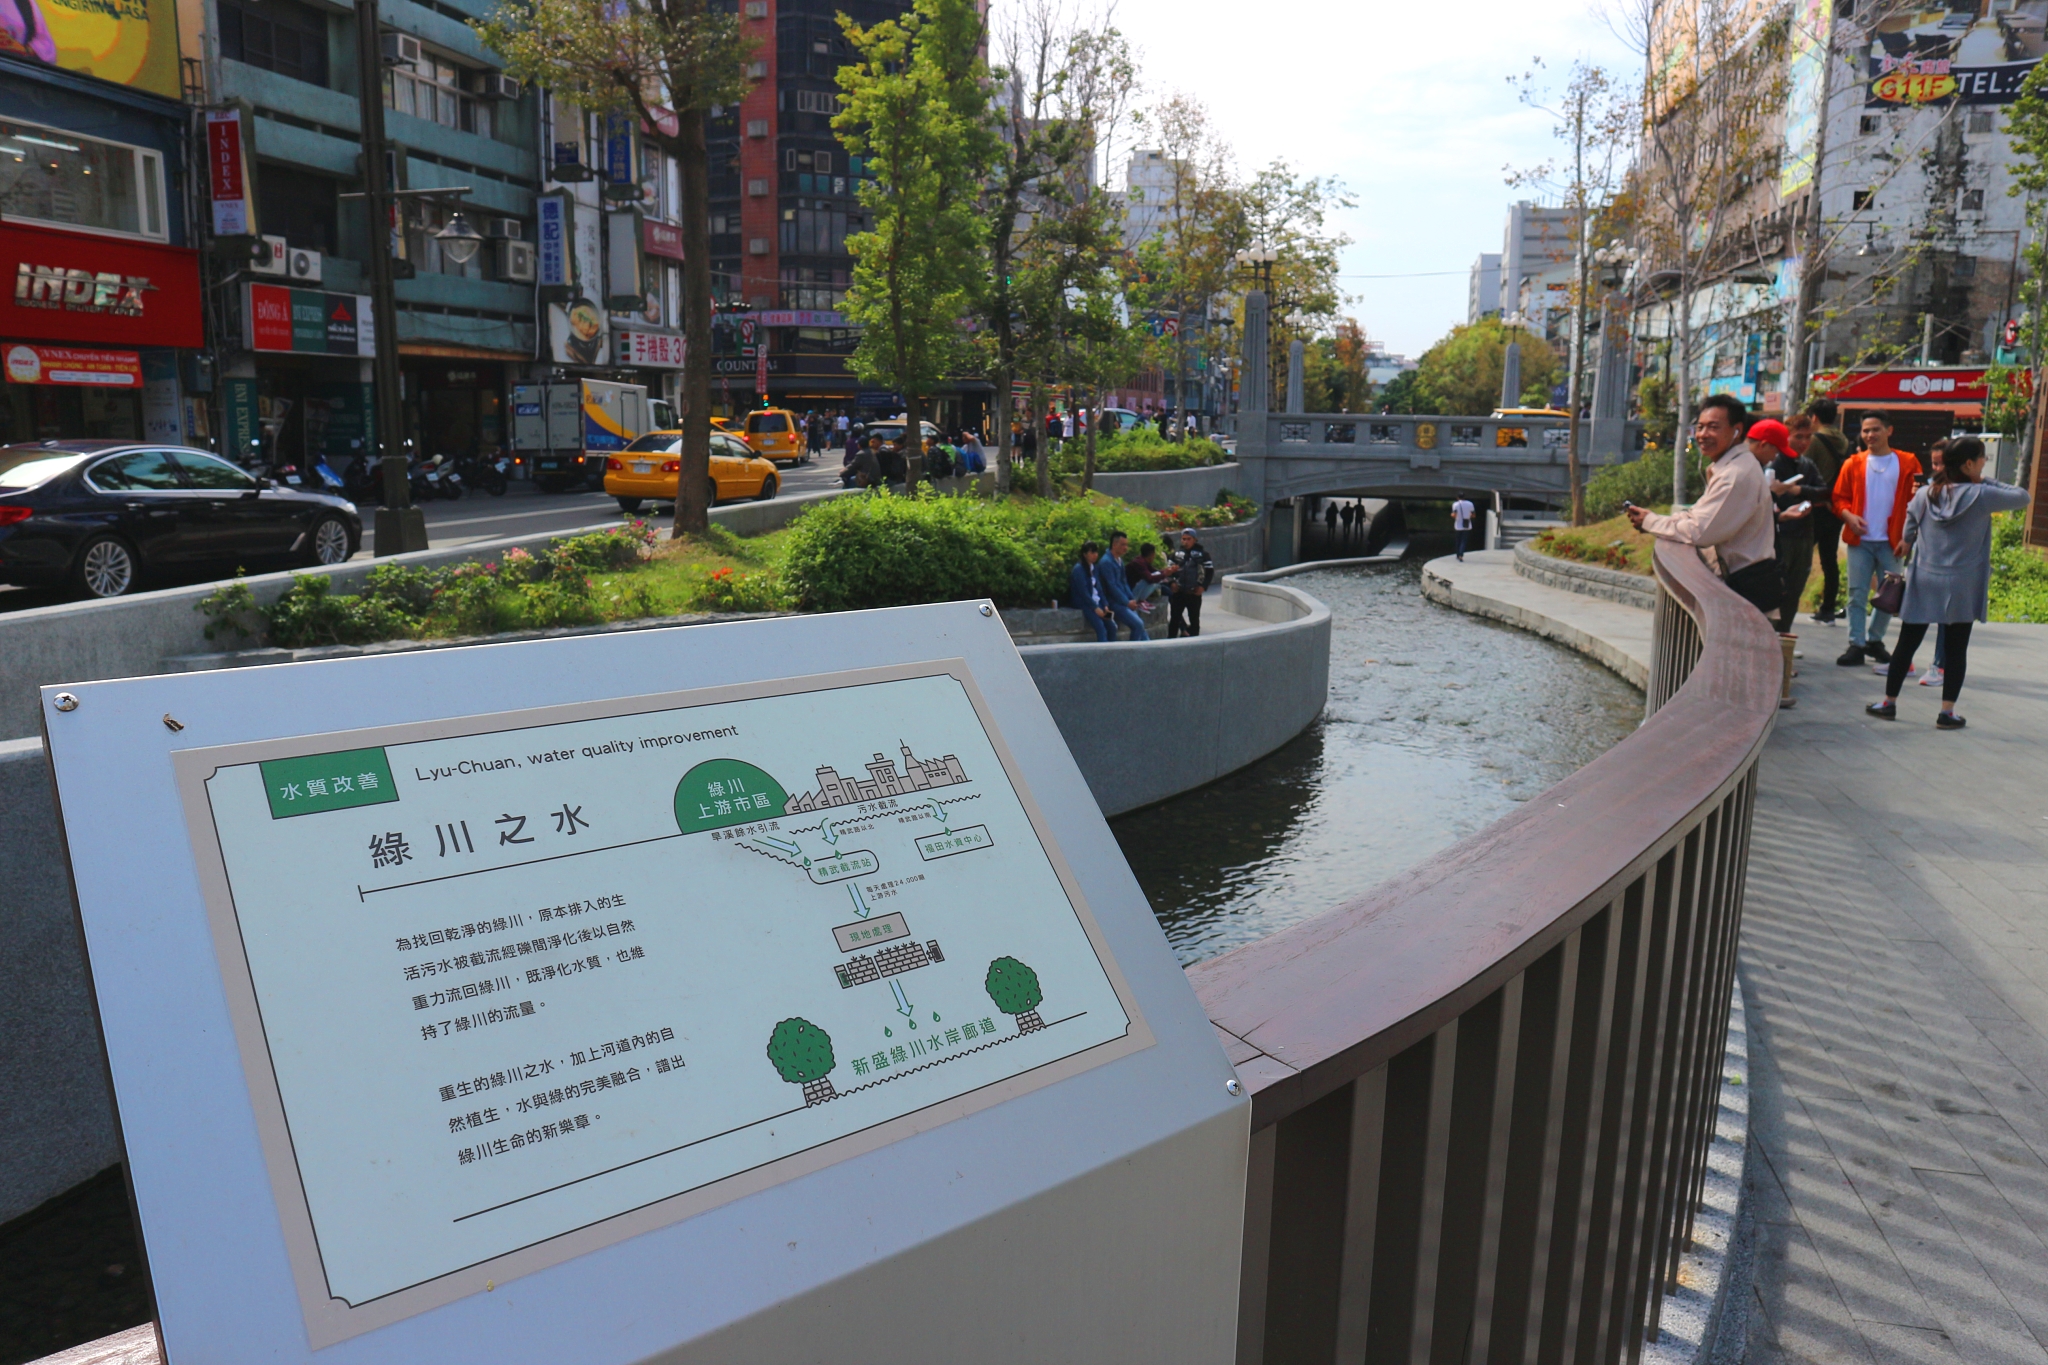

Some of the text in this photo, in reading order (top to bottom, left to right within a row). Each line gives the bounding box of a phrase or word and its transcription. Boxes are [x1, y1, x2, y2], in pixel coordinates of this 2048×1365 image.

[220, 125, 232, 190] INDEX
[15, 262, 150, 309] INDEX
[234, 383, 248, 403] BNI
[415, 724, 739, 782] Lyu-Chuan, water quality improvement
[279, 772, 379, 801] 水質改善
[707, 777, 745, 798] 綠川
[698, 792, 772, 819] 上游市區
[368, 803, 590, 869] 綠川之水
[817, 857, 872, 878] 精武截流站
[849, 923, 894, 943] 現地處理
[851, 1016, 997, 1077] 新盛綠川水岸廊道
